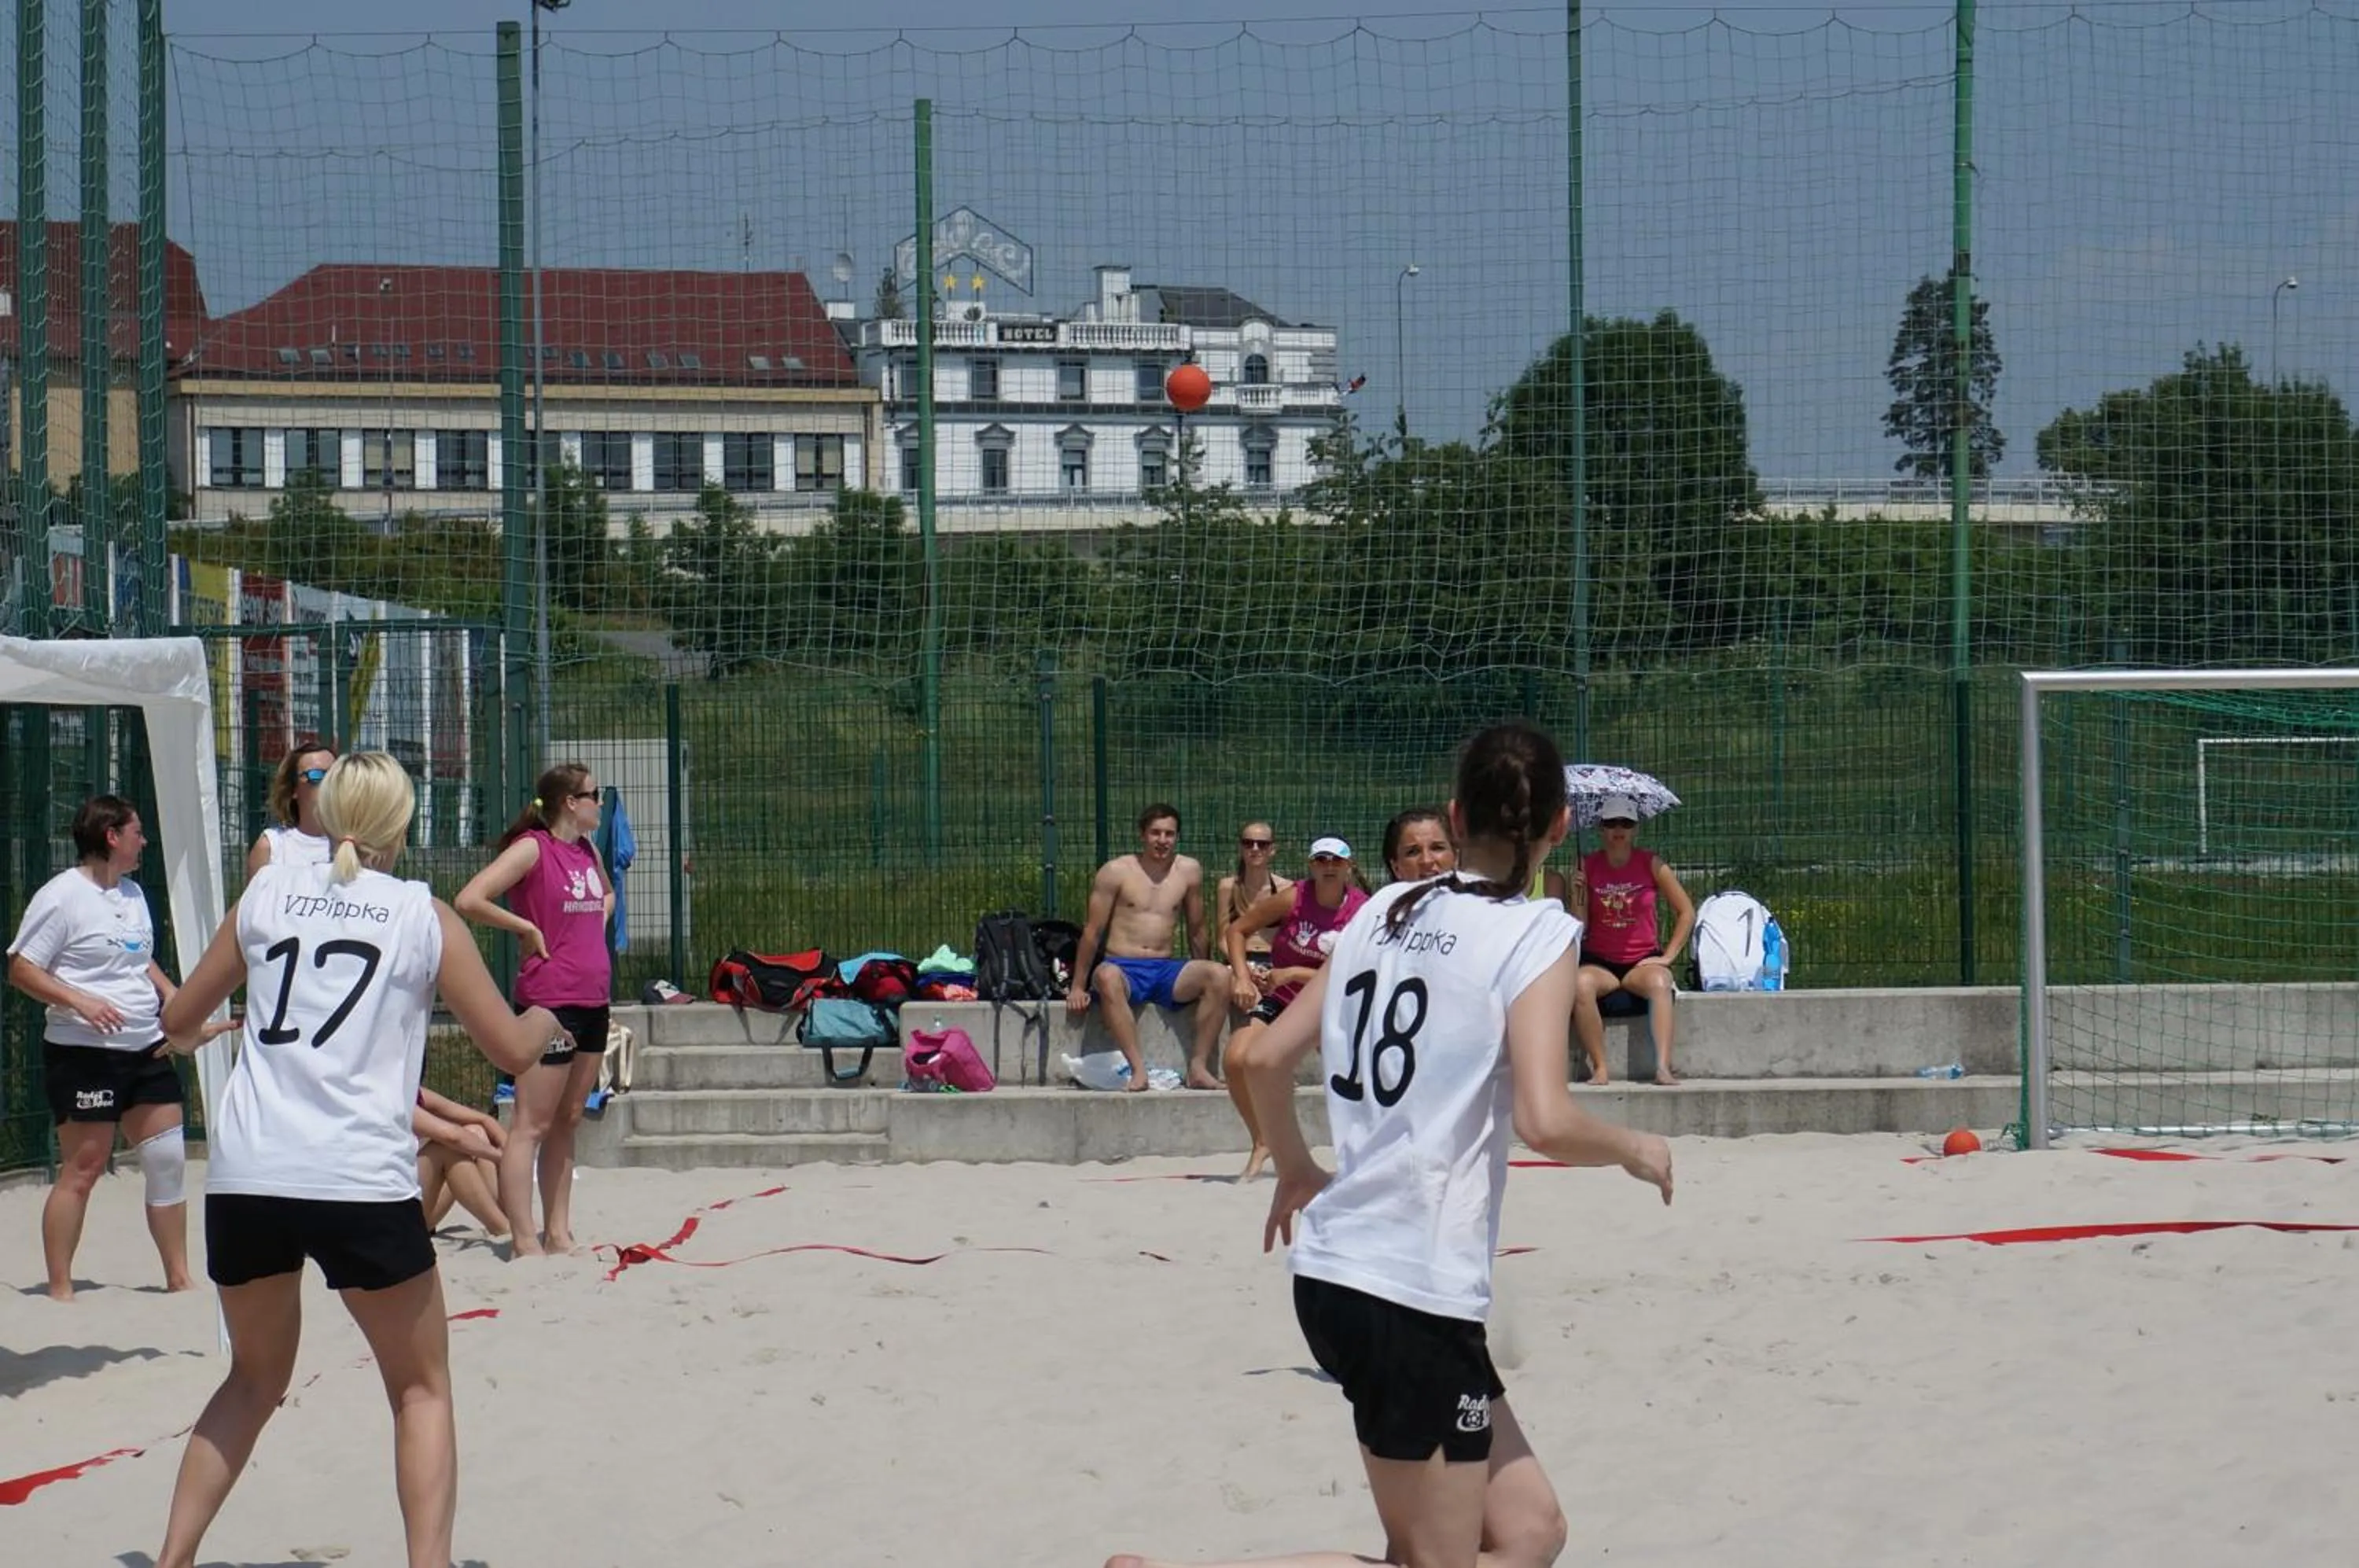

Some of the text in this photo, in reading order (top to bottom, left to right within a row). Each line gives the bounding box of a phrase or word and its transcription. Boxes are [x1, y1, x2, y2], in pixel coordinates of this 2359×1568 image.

[1003, 328, 1054, 340] HOTEL
[285, 894, 389, 923] VIPippka
[259, 937, 381, 1049] 17
[1330, 969, 1428, 1108] 18
